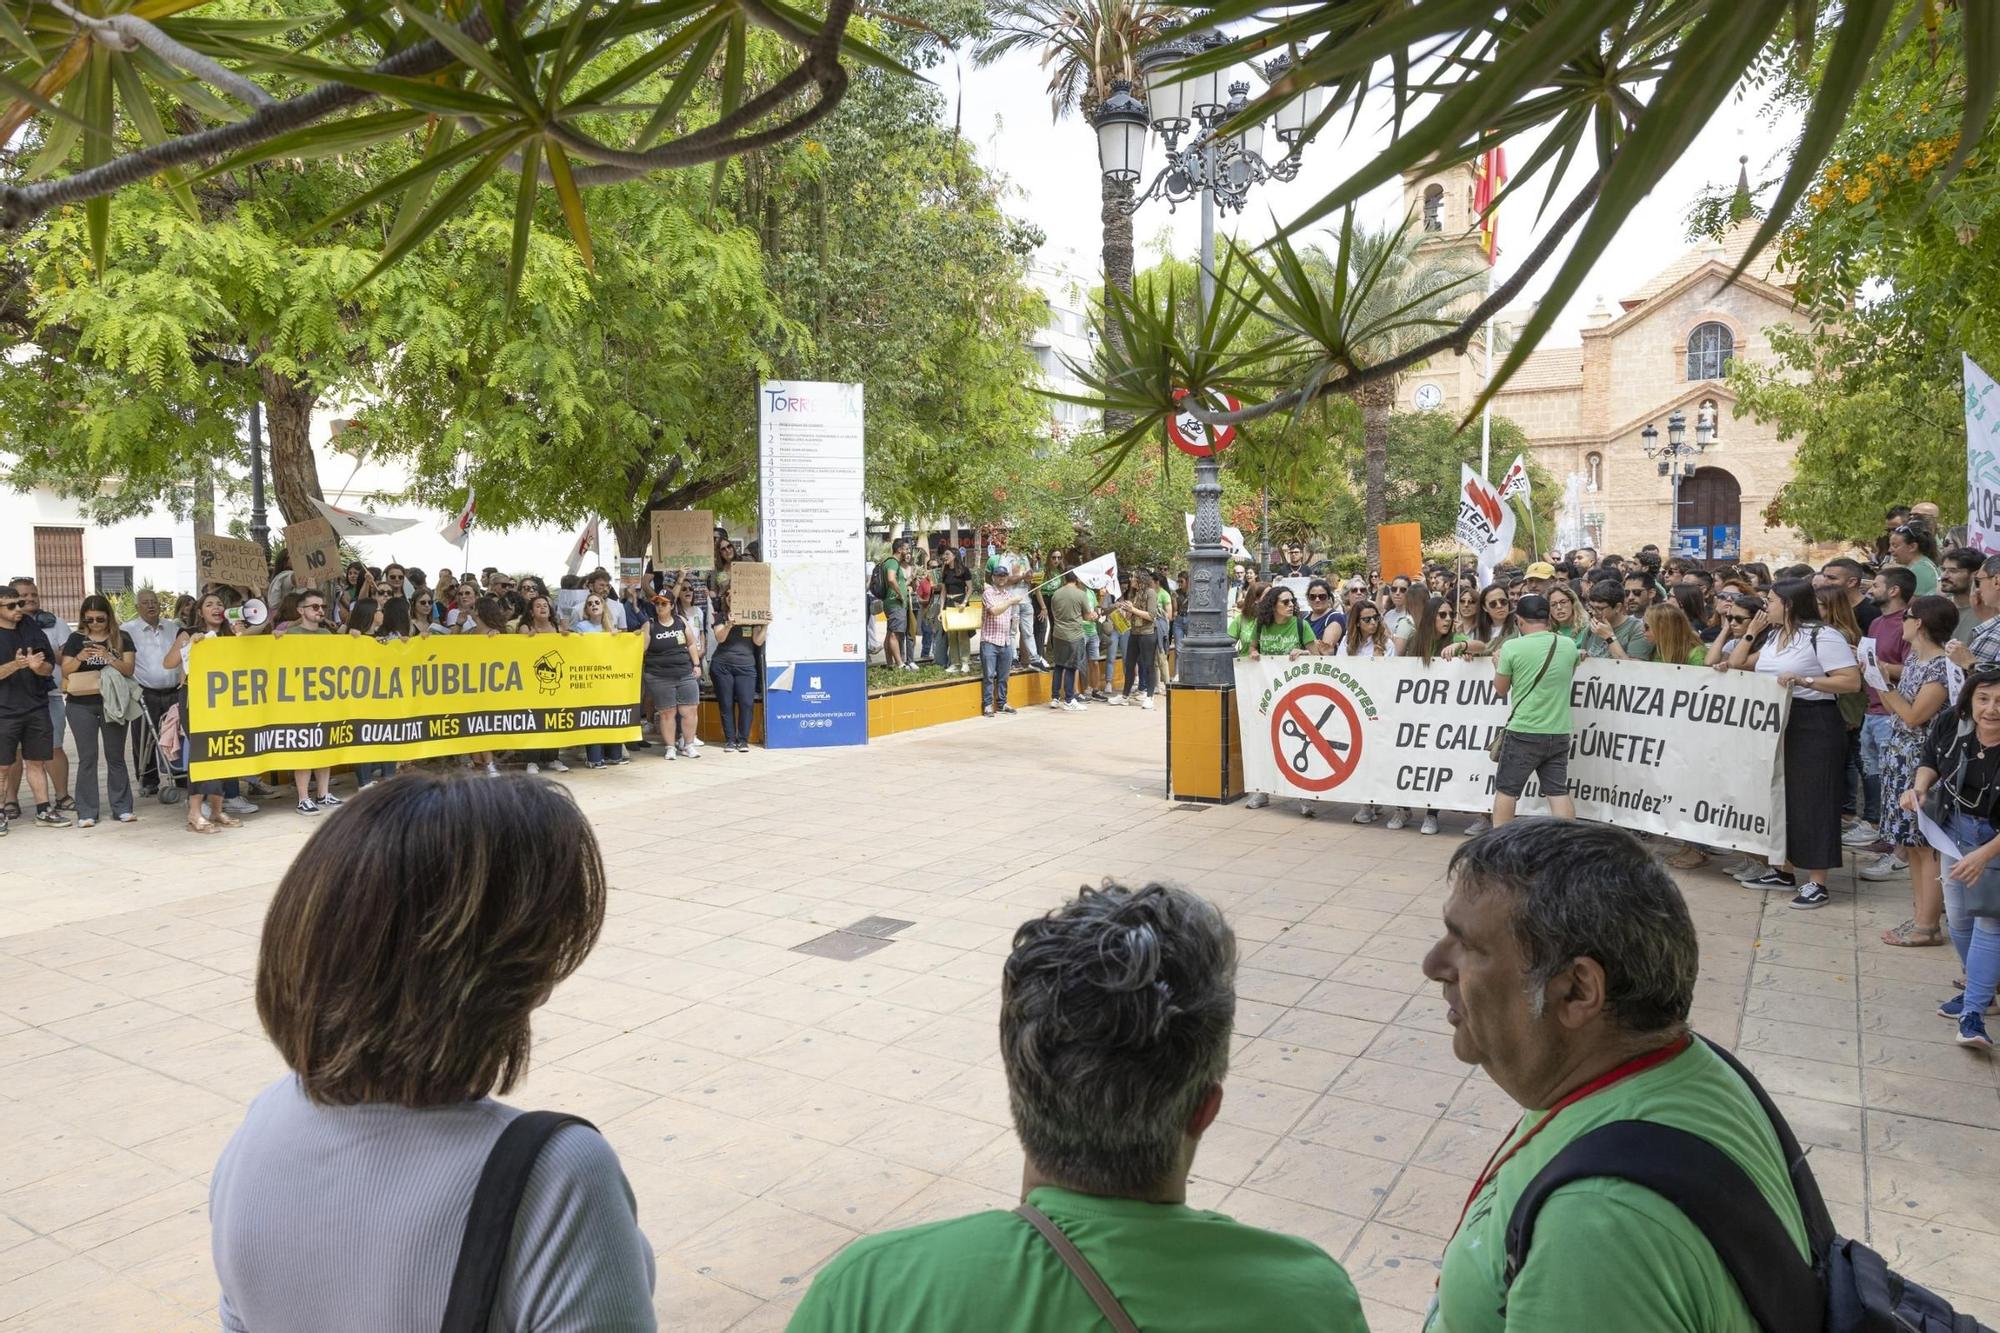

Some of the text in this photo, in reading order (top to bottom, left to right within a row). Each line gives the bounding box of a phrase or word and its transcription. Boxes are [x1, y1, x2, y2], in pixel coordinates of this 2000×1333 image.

[768, 519, 777, 527] 10
[769, 529, 777, 537] 11
[768, 540, 777, 548] 12
[768, 550, 777, 558] 13
[306, 550, 326, 569] NO
[656, 630, 682, 639] adida
[207, 655, 524, 708] PER L'ESCOLA PÚBLICA
[1272, 678, 1284, 692] A
[1284, 662, 1310, 683] LOS
[1395, 676, 1781, 734] POR UNA EÑANZA PÚBLICA
[207, 708, 632, 757] MÉS INVERSIÓ MÉS QUALITAT MÉS VALENCIÀ MÉS DIGNITAT
[1395, 722, 1431, 749] DE
[1569, 722, 1666, 767] ¡ÚNETE!
[1396, 765, 1453, 793] CEIP
